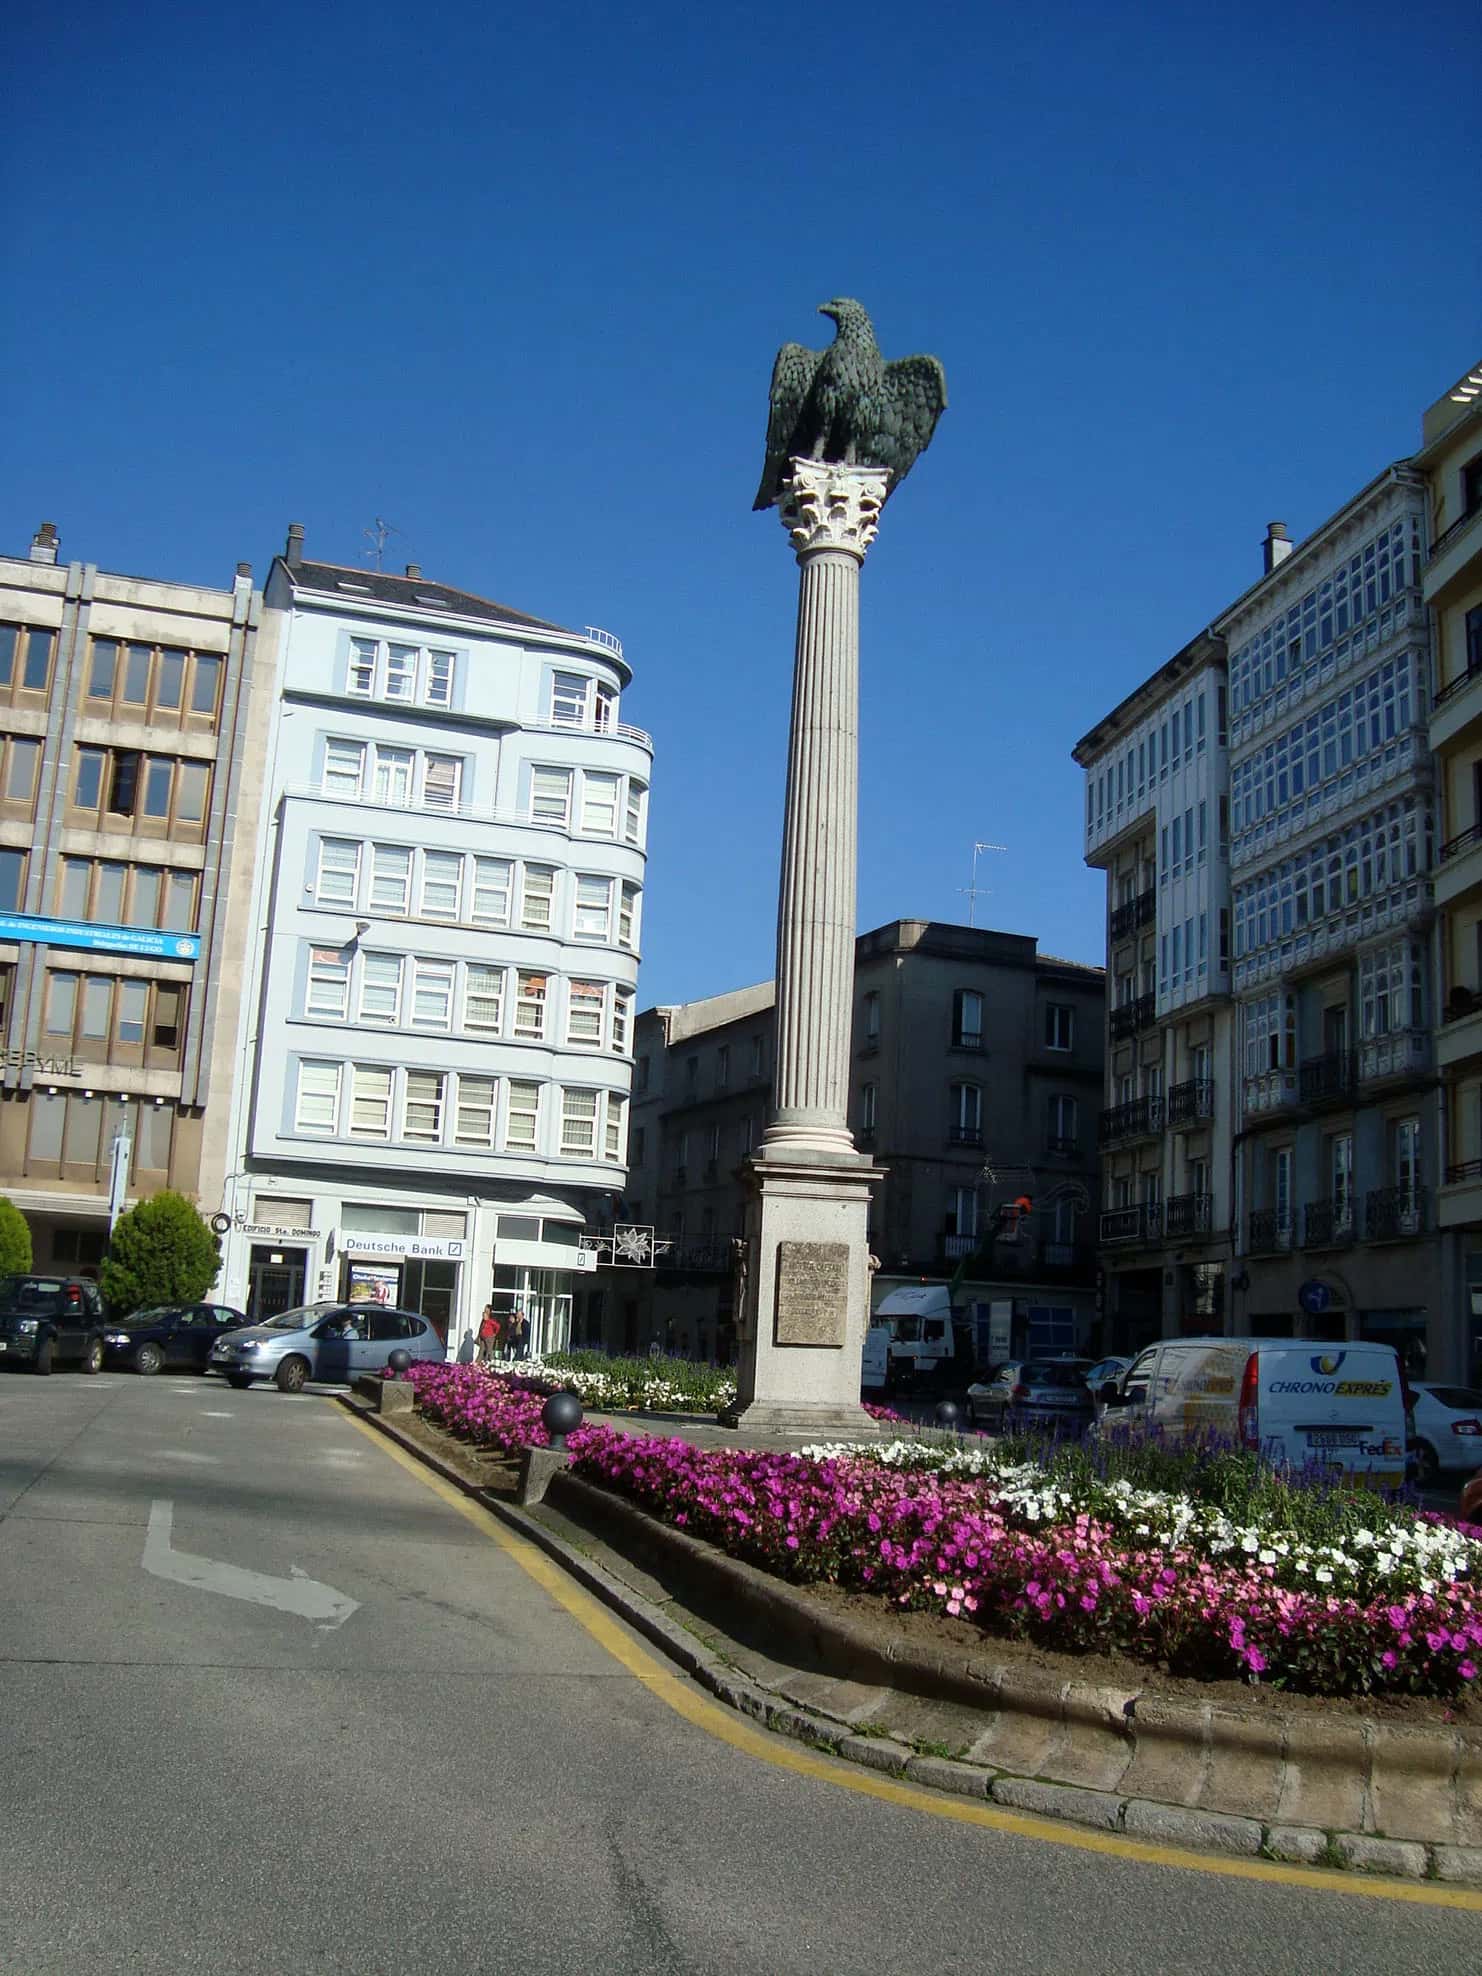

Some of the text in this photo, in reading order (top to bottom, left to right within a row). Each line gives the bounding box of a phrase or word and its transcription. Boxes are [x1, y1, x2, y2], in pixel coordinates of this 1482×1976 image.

[346, 1238, 443, 1255] Deutsche Bank
[1359, 1440, 1401, 1456] FedEx
